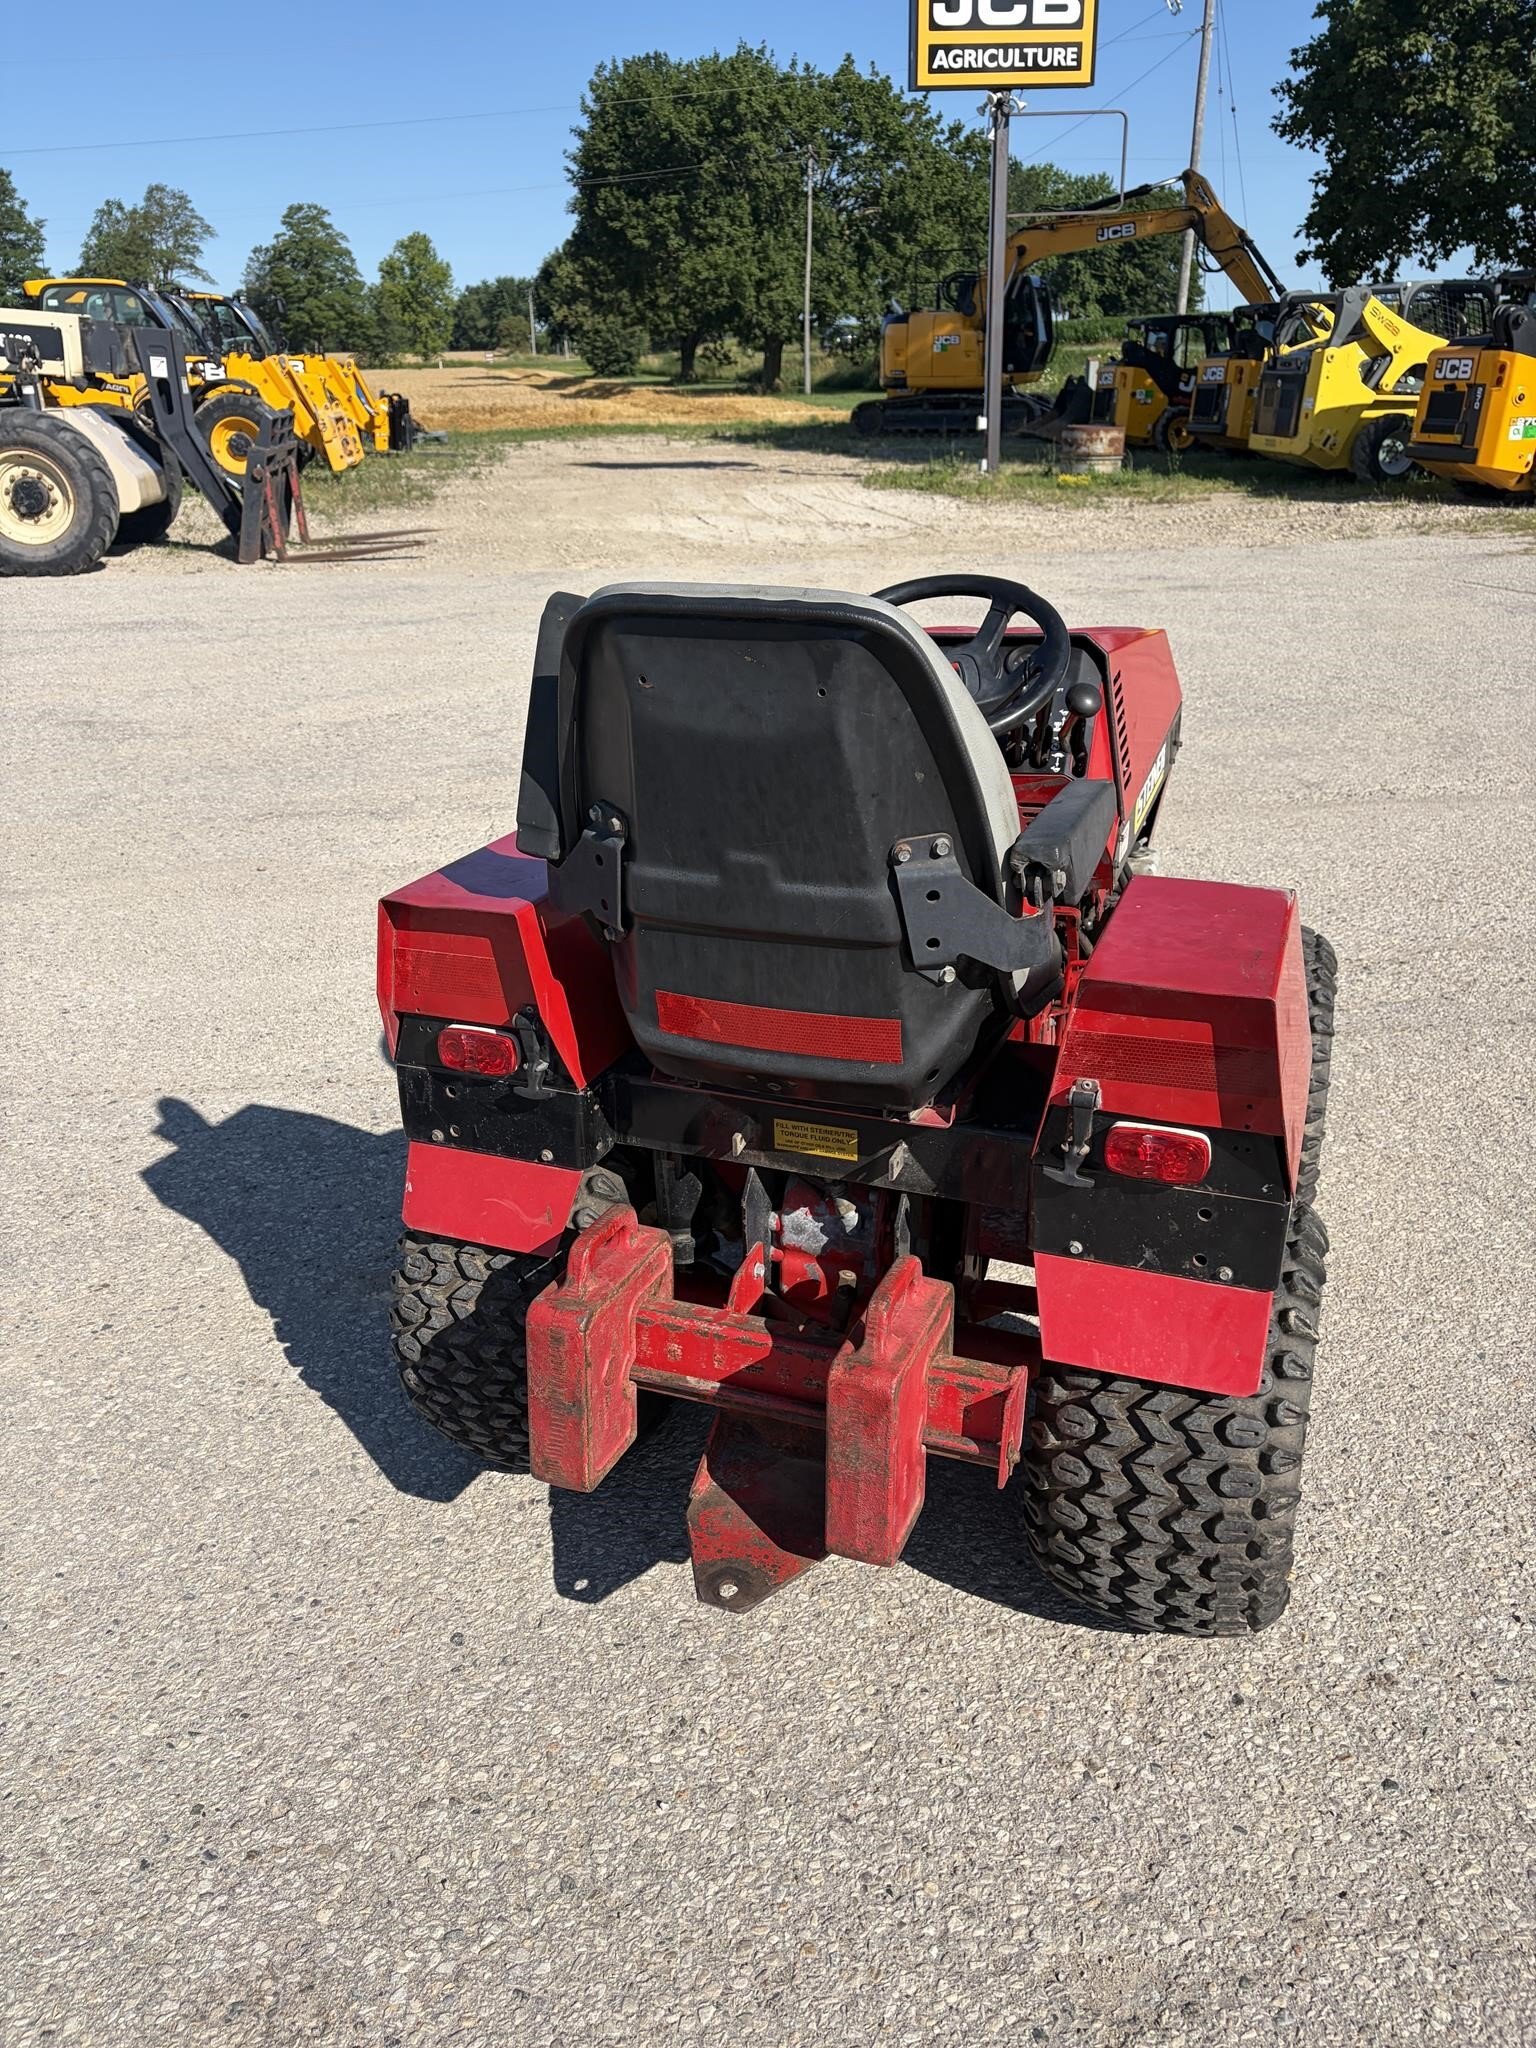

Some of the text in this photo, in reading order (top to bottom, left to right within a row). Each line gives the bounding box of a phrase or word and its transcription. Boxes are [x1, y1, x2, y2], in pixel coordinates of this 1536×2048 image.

[932, 47, 1078, 69] AGRICULTURE
[1097, 222, 1136, 241] JCB
[934, 335, 960, 344] JCB
[1202, 367, 1225, 381] JCB
[1435, 359, 1473, 379] JCB
[776, 1122, 789, 1130] FILL
[791, 1124, 809, 1132] WITH
[810, 1134, 831, 1143] FLUID
[832, 1137, 851, 1145] ONLY
